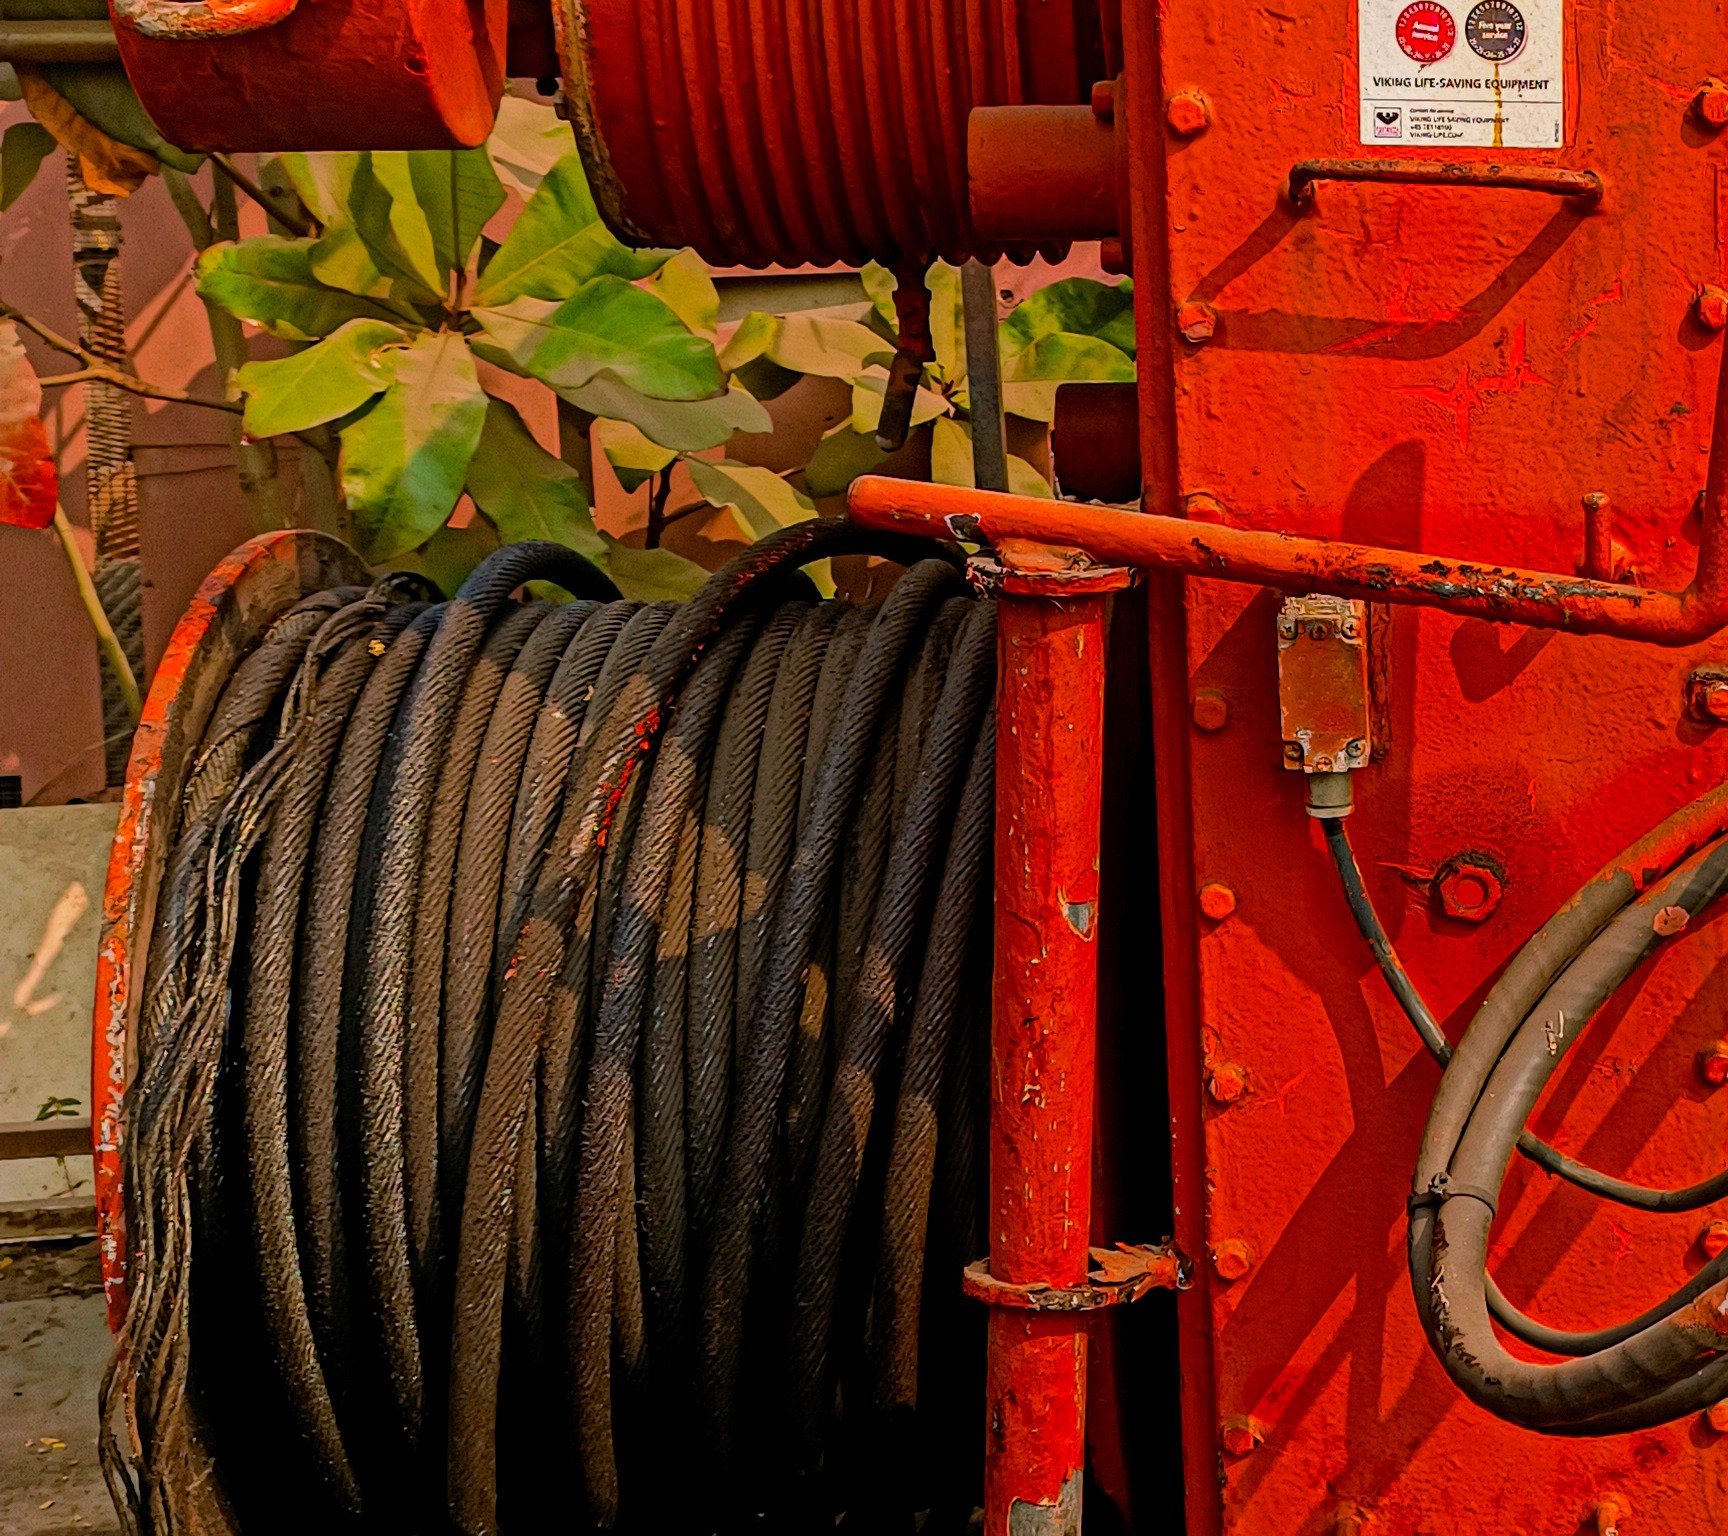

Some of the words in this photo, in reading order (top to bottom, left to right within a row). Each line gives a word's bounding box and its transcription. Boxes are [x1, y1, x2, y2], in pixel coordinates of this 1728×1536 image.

[1373, 76, 1411, 88] VIKING
[1415, 77, 1481, 89] LIFE-SAVING
[1485, 78, 1550, 90] EQUIPMENT
